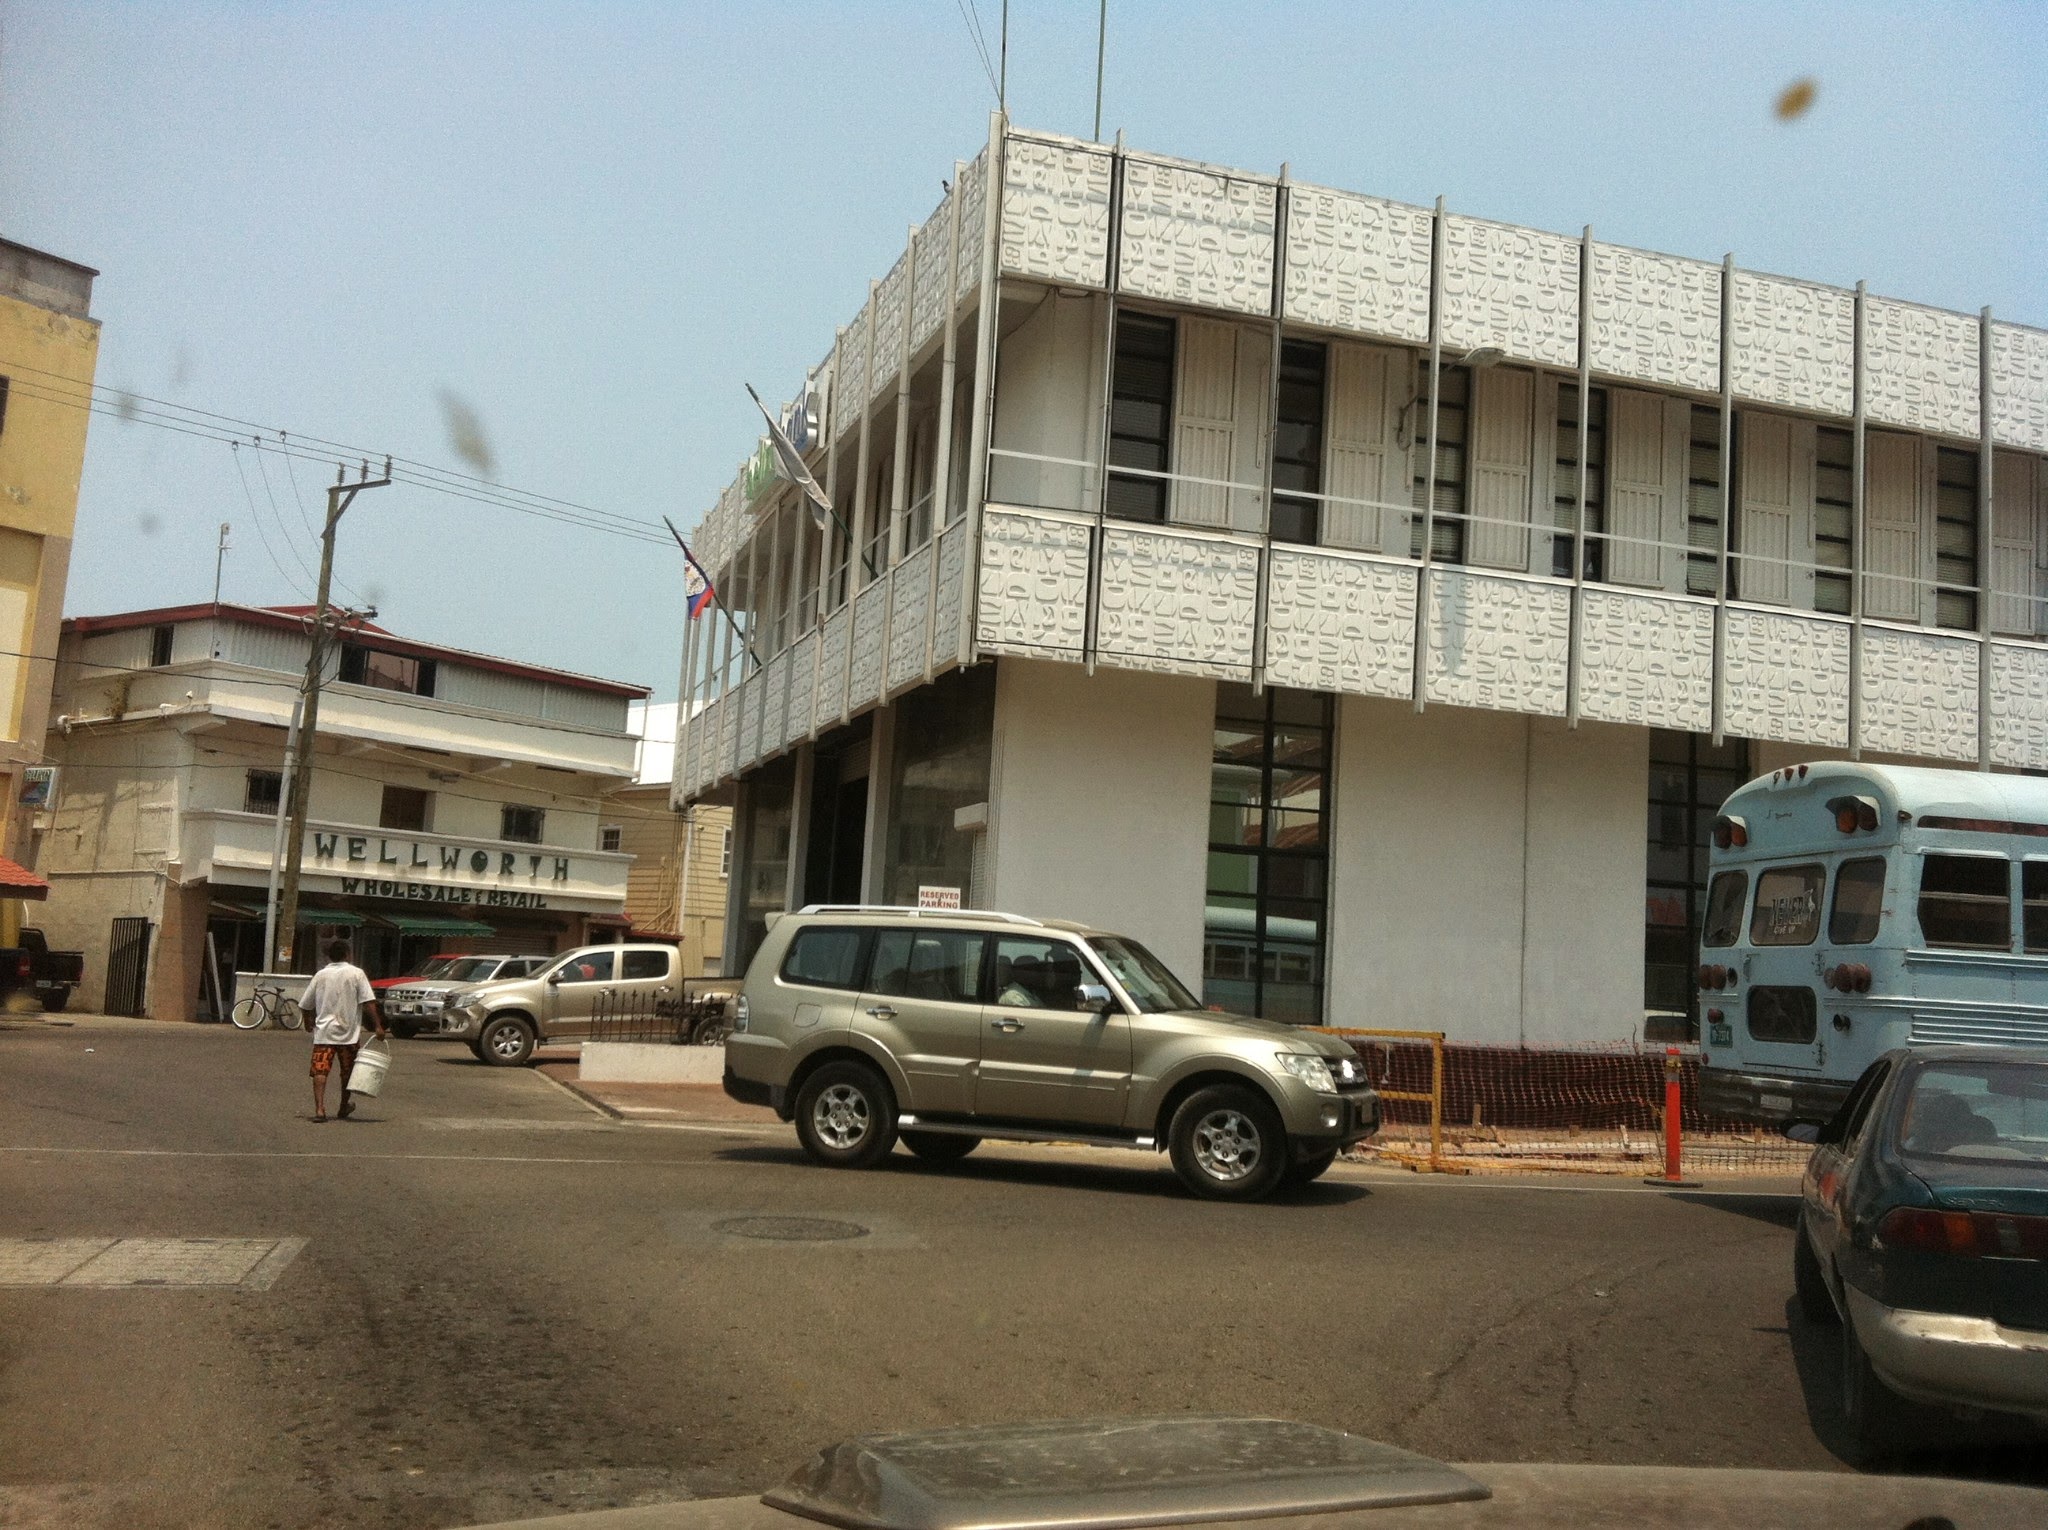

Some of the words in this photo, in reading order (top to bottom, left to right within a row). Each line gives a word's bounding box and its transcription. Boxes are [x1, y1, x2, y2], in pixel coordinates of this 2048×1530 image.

[314, 833, 569, 881] WELLWORTH
[341, 877, 471, 904] WHOLESALE
[487, 890, 547, 909] RETAIL
[920, 890, 959, 900] RESERVED
[920, 900, 958, 909] PARKING
